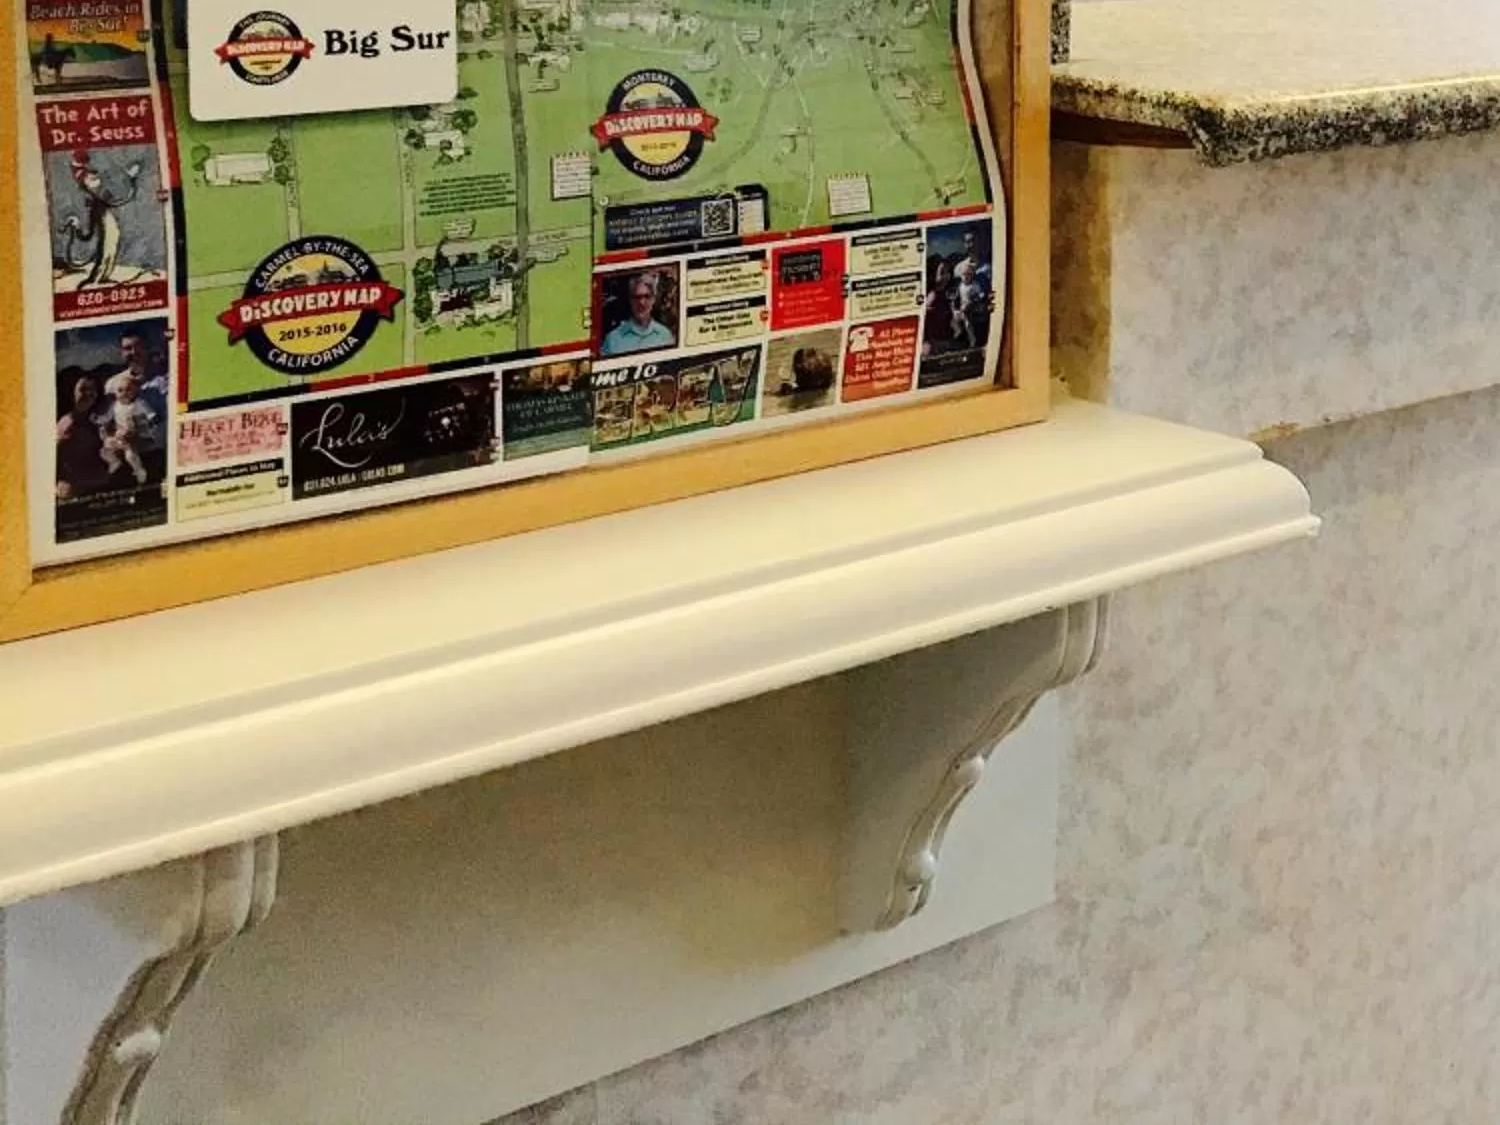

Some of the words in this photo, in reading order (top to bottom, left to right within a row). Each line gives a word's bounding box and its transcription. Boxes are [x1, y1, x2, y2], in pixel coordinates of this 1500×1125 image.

[80, 1, 119, 16] Rides
[125, 0, 139, 13] in
[323, 28, 380, 58] Big
[390, 26, 452, 53] Sur
[623, 72, 675, 90] MONTEREY
[41, 108, 78, 125] The
[87, 106, 119, 122] Art
[129, 102, 149, 117] of
[676, 112, 703, 127] MAP
[51, 128, 82, 145] Dr.
[90, 125, 145, 143] Seuss
[633, 155, 690, 175] CALIFORNIA
[343, 286, 382, 306] MAP
[279, 322, 348, 342] 2015-2016
[267, 336, 360, 368] CALIFORNIA
